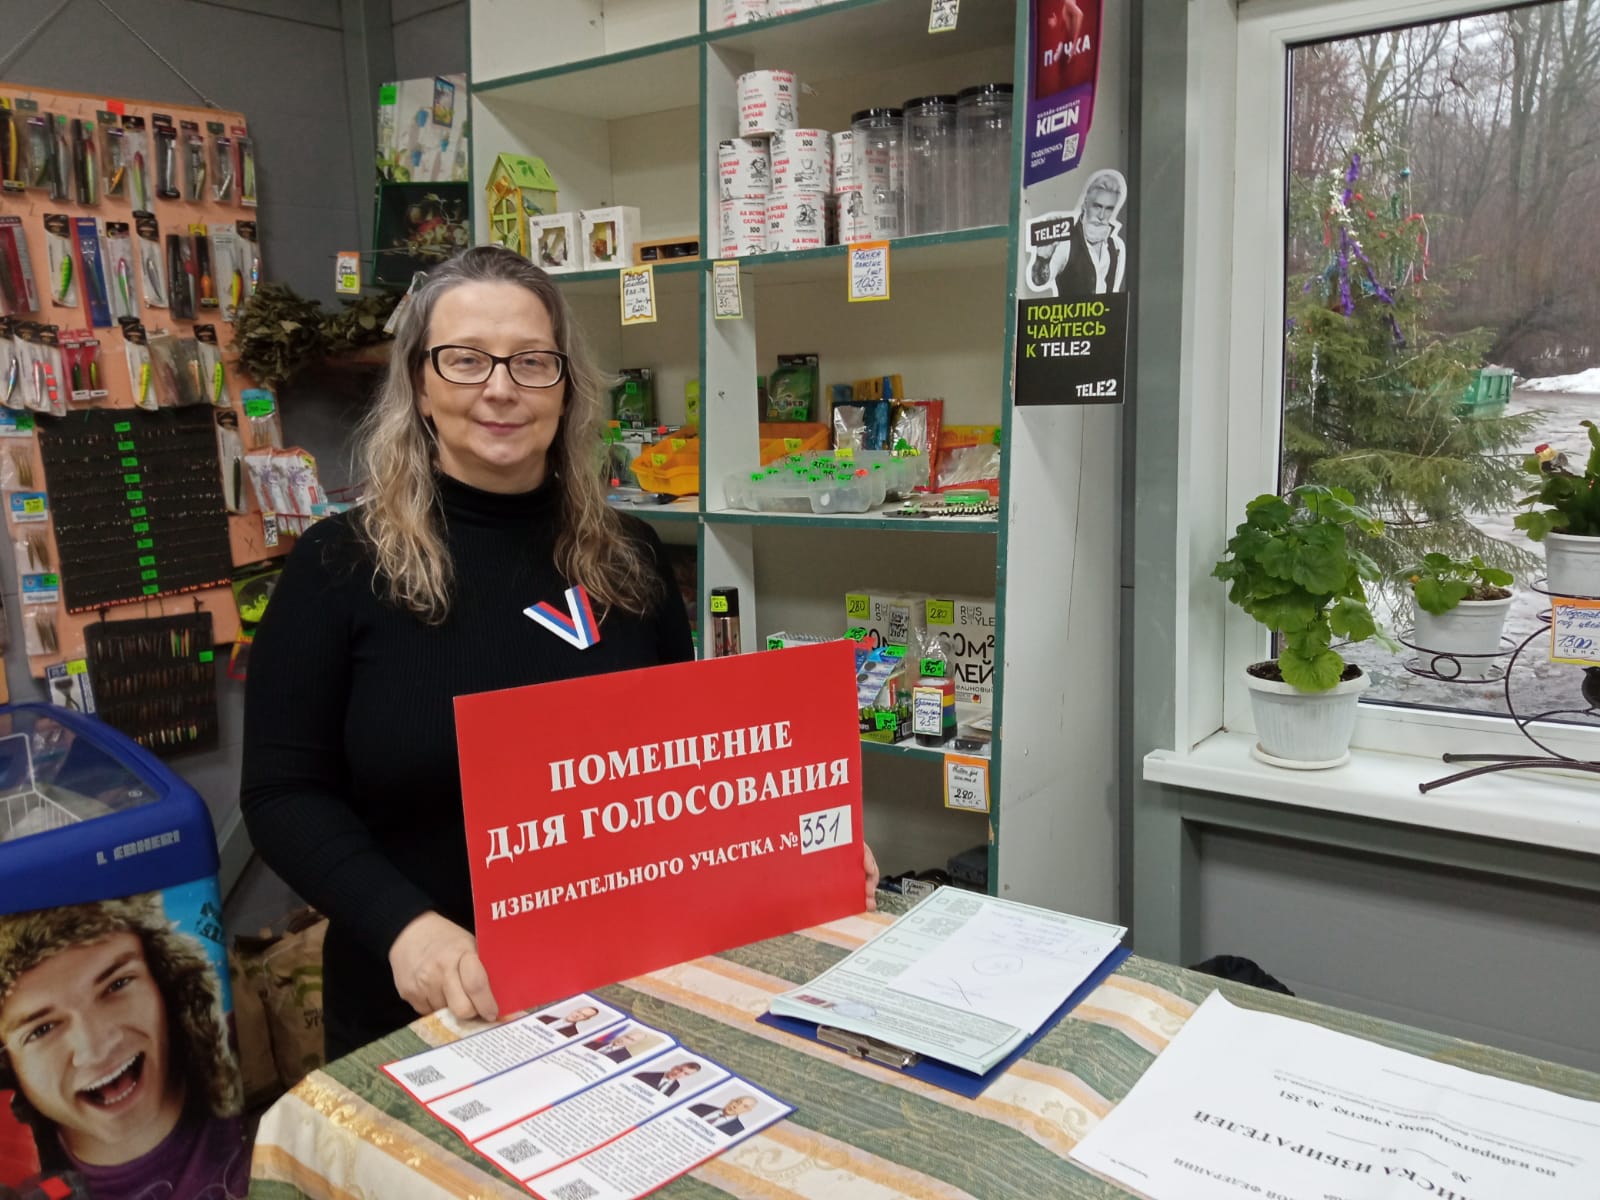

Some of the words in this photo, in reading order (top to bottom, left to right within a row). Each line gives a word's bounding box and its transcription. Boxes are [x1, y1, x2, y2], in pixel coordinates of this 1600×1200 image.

[1036, 105, 1080, 138] KION
[1034, 220, 1071, 242] TELE2
[1027, 301, 1110, 321] ПОДКЛЮ-
[1027, 317, 1106, 339] ЧАЙТЕСЬ
[1026, 343, 1037, 358] К
[1041, 340, 1091, 357] TELE2
[1075, 378, 1117, 397] TELE2
[849, 600, 866, 613] 280
[955, 659, 994, 684] ЛЕЙ
[548, 720, 793, 792] ПОМЕЩЕНИЕ
[485, 814, 568, 869] ДЛЯ
[580, 758, 849, 839] ГОЛОСОВАНИЯ
[490, 858, 684, 921] ИЗБИРАТЕЛЬНОГО
[689, 837, 774, 871] УЧАСТКА
[779, 831, 799, 850] №
[802, 811, 840, 848] 351
[1331, 1105, 1393, 1127] участку
[1193, 1110, 1374, 1175] ИЗБИРАТЕЛЕЙ
[1383, 1165, 1476, 1200] ИСКА
